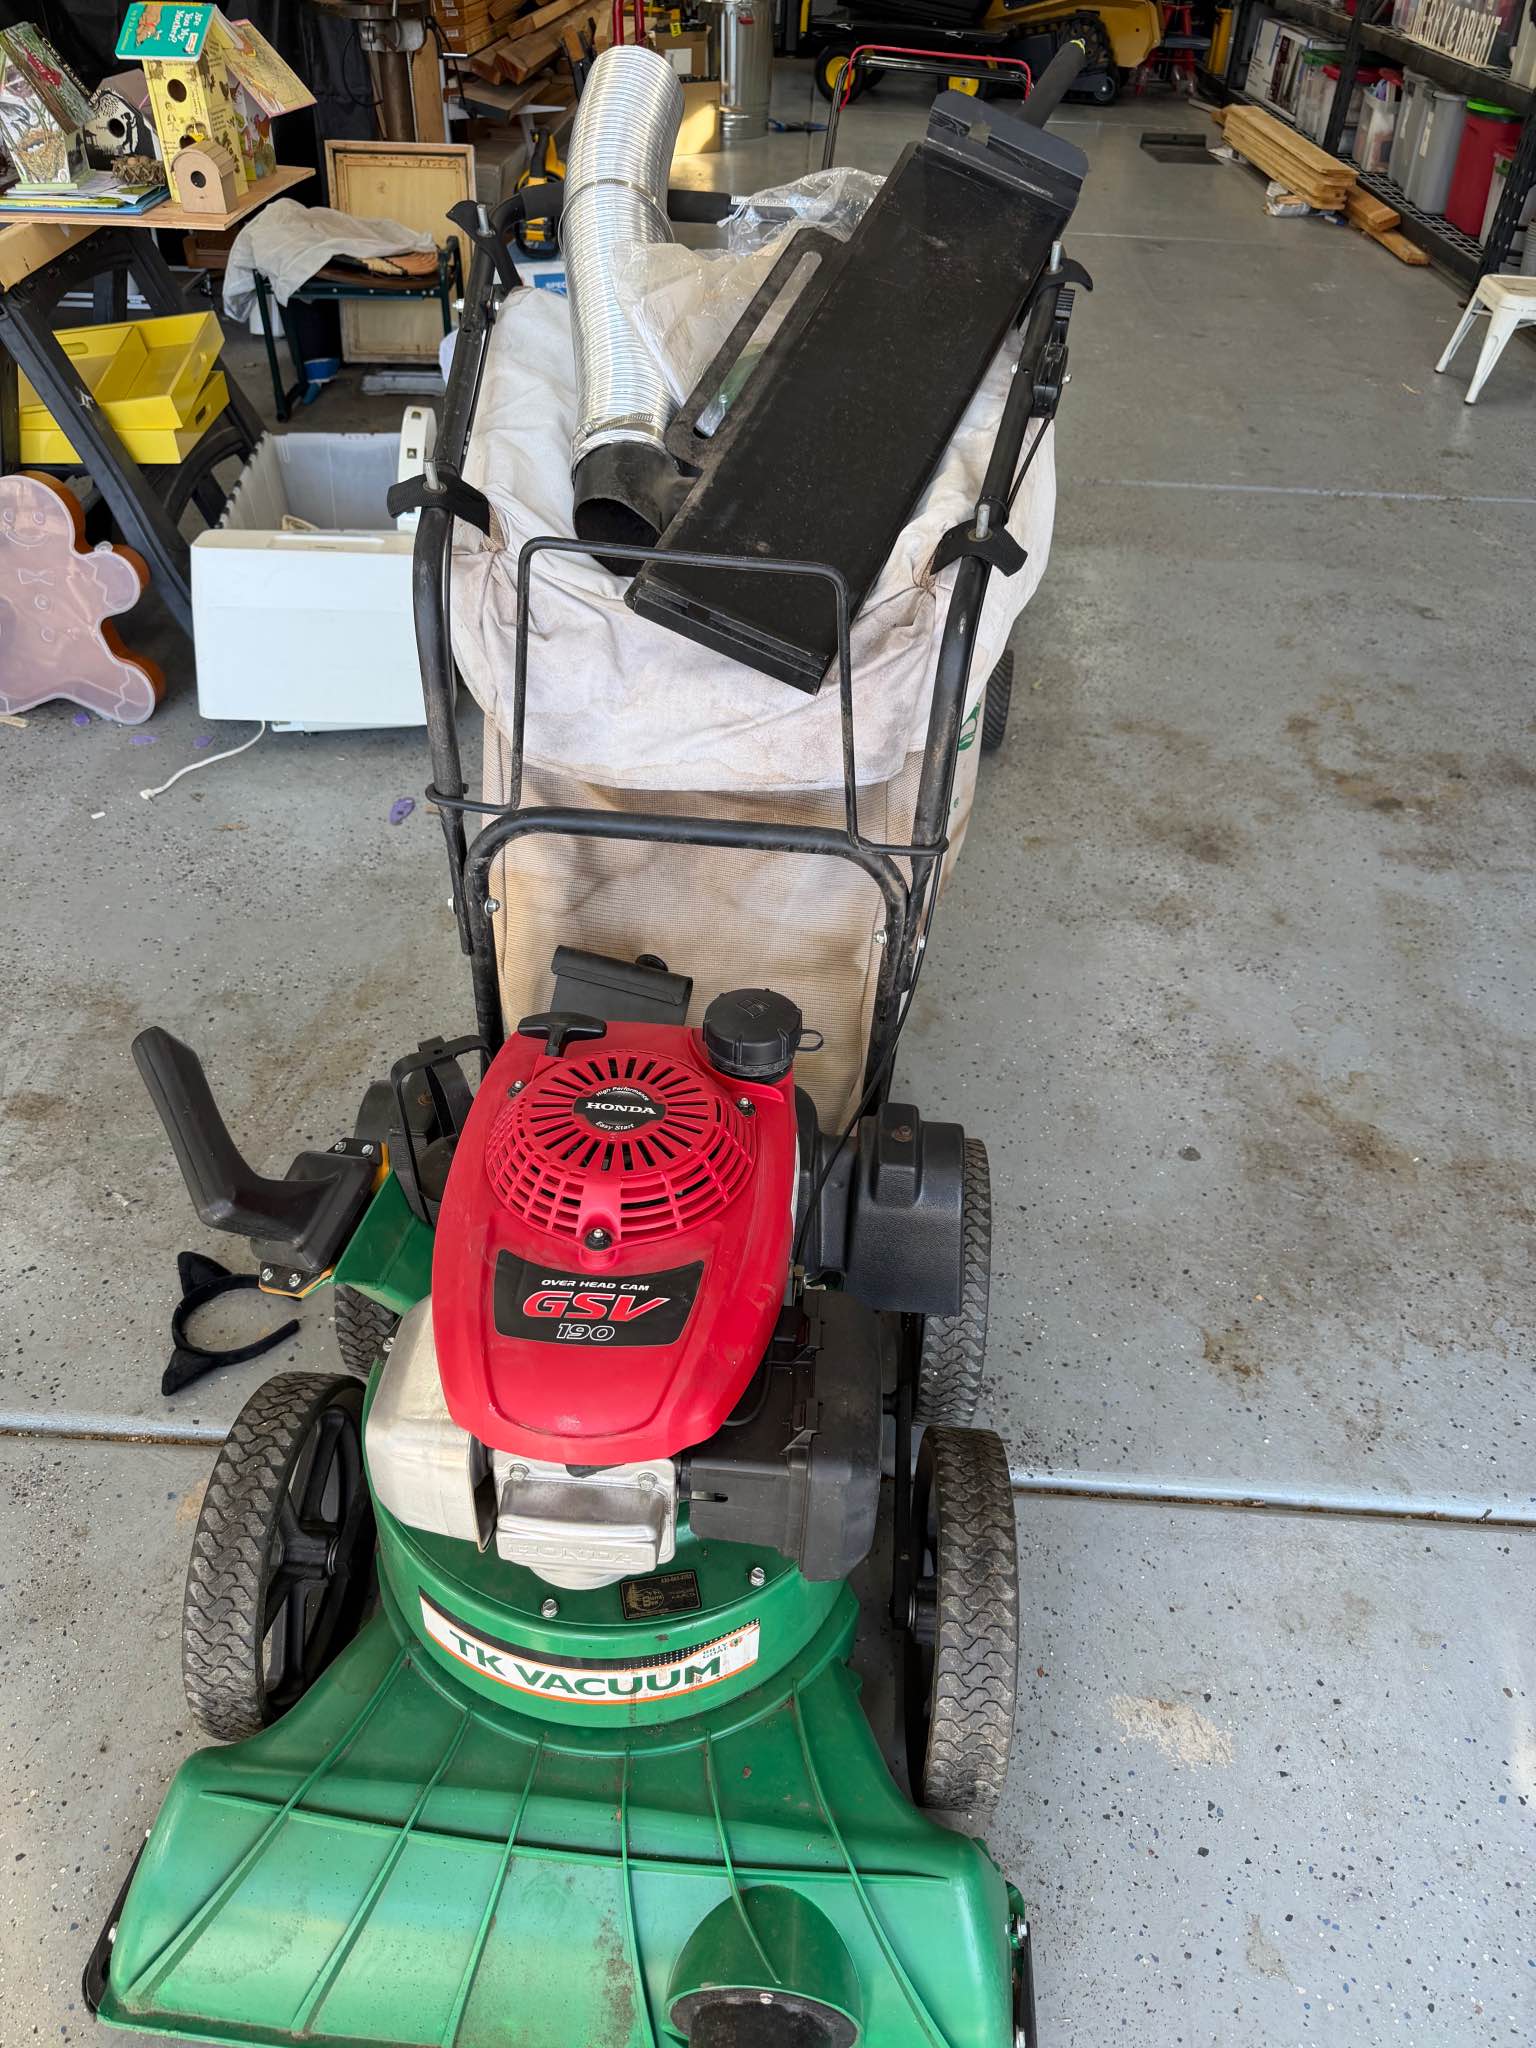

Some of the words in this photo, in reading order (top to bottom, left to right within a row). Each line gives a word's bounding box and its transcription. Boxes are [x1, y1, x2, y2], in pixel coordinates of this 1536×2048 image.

[183, 12, 194, 27] You
[193, 11, 203, 27] Are
[1410, 0, 1454, 47] MERRY
[1445, 5, 1461, 51] &
[1453, 8, 1502, 66] BRIGHT
[596, 1087, 611, 1098] High
[612, 1086, 650, 1101] Performance
[585, 1101, 656, 1115] HONDA
[596, 1121, 612, 1131] Easy
[614, 1123, 635, 1131] Start
[541, 1279, 576, 1287] OVER
[579, 1281, 617, 1289] HEAD
[620, 1283, 650, 1291] CAM
[522, 1290, 671, 1322] GSV
[556, 1323, 615, 1342] 190
[450, 1630, 507, 1677] TK
[513, 1656, 721, 1696] VACUUM
